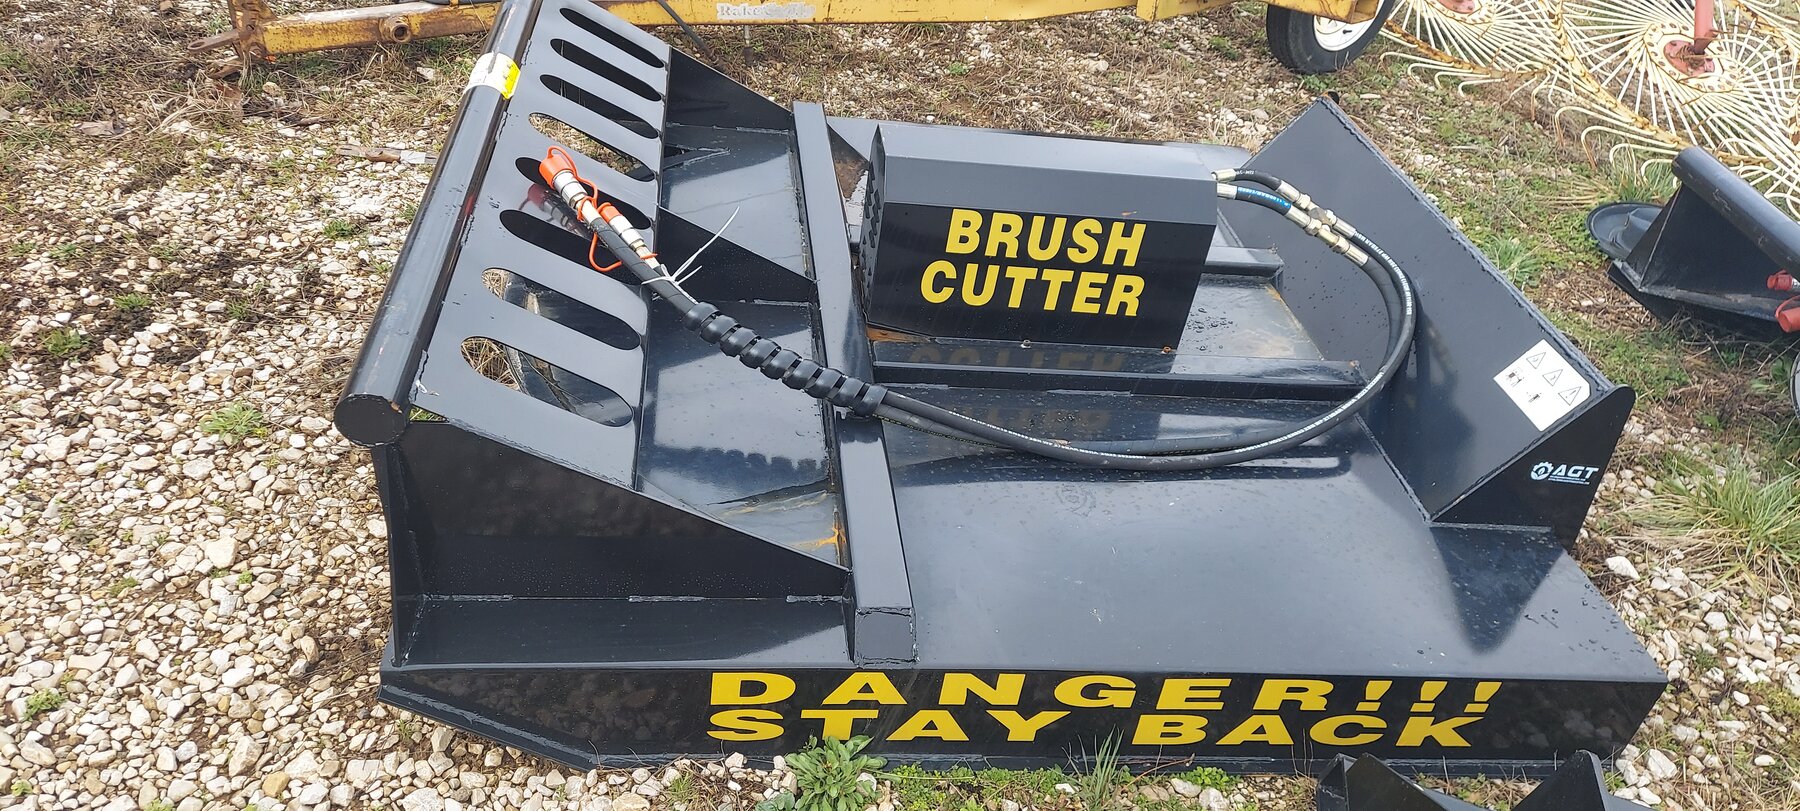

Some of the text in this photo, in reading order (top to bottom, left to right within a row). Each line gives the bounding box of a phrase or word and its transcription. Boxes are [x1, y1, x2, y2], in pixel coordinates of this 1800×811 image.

[945, 208, 1147, 267] BRUSH
[920, 260, 1145, 316] CUTTER
[1552, 464, 1599, 479] AGT
[711, 672, 1502, 713] DANGER!!!
[707, 709, 1484, 747] STAY BACK
